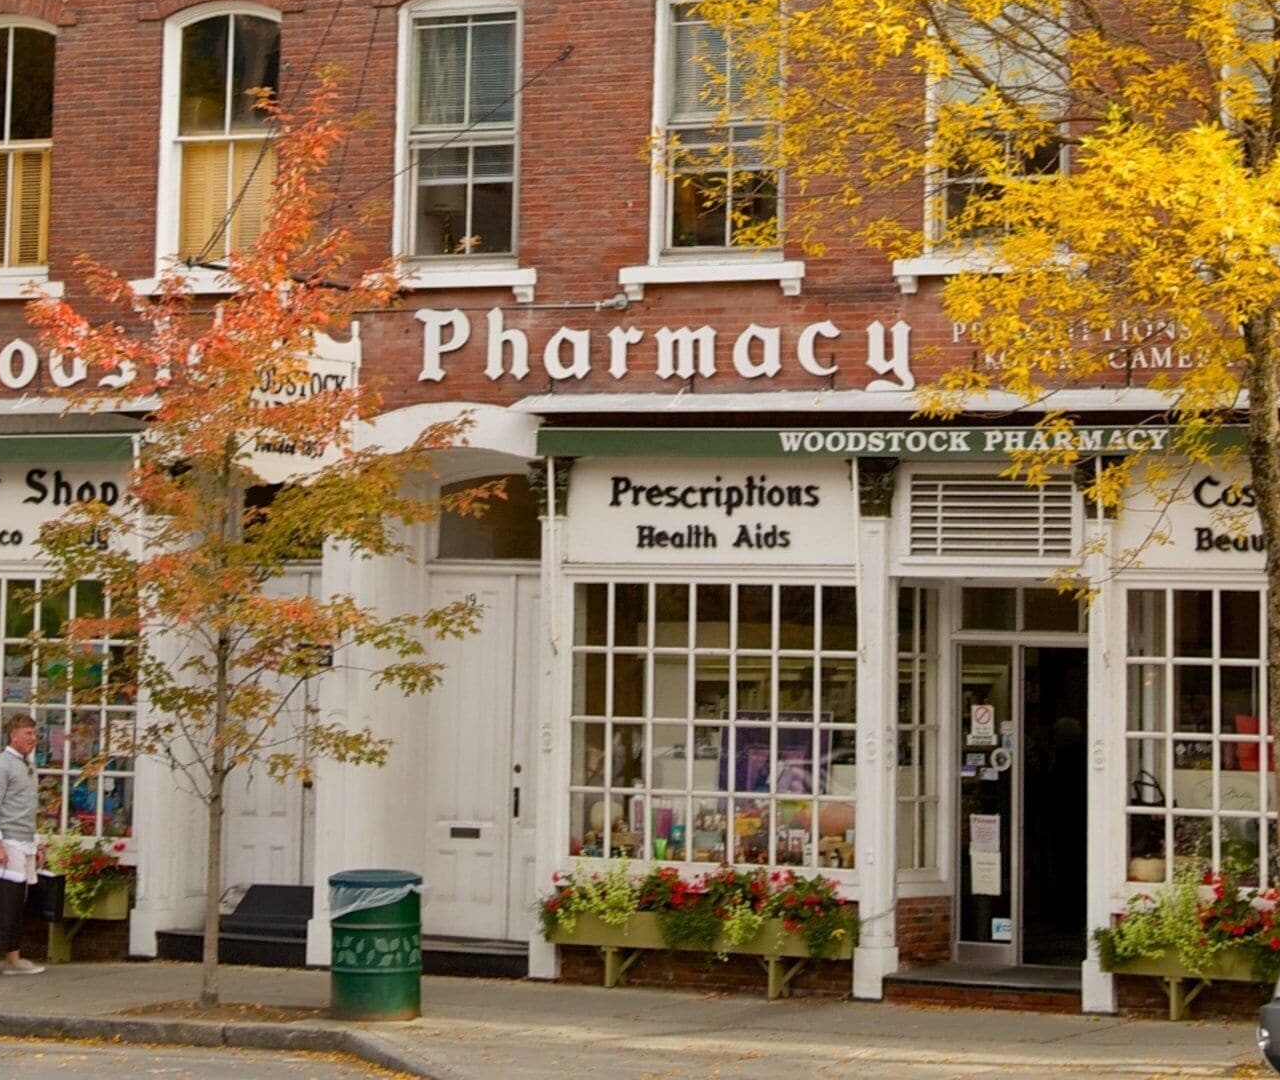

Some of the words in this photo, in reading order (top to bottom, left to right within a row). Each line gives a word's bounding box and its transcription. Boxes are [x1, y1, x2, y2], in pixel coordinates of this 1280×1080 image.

[414, 307, 916, 392] Pharmacy
[779, 431, 971, 452] WOODSTOCK
[983, 429, 1169, 452] PHARMACY
[22, 469, 119, 507] Shop
[609, 475, 820, 516] Prescriptions
[636, 524, 718, 549] Health
[732, 523, 791, 549] Aids
[1195, 526, 1267, 552] Beau
